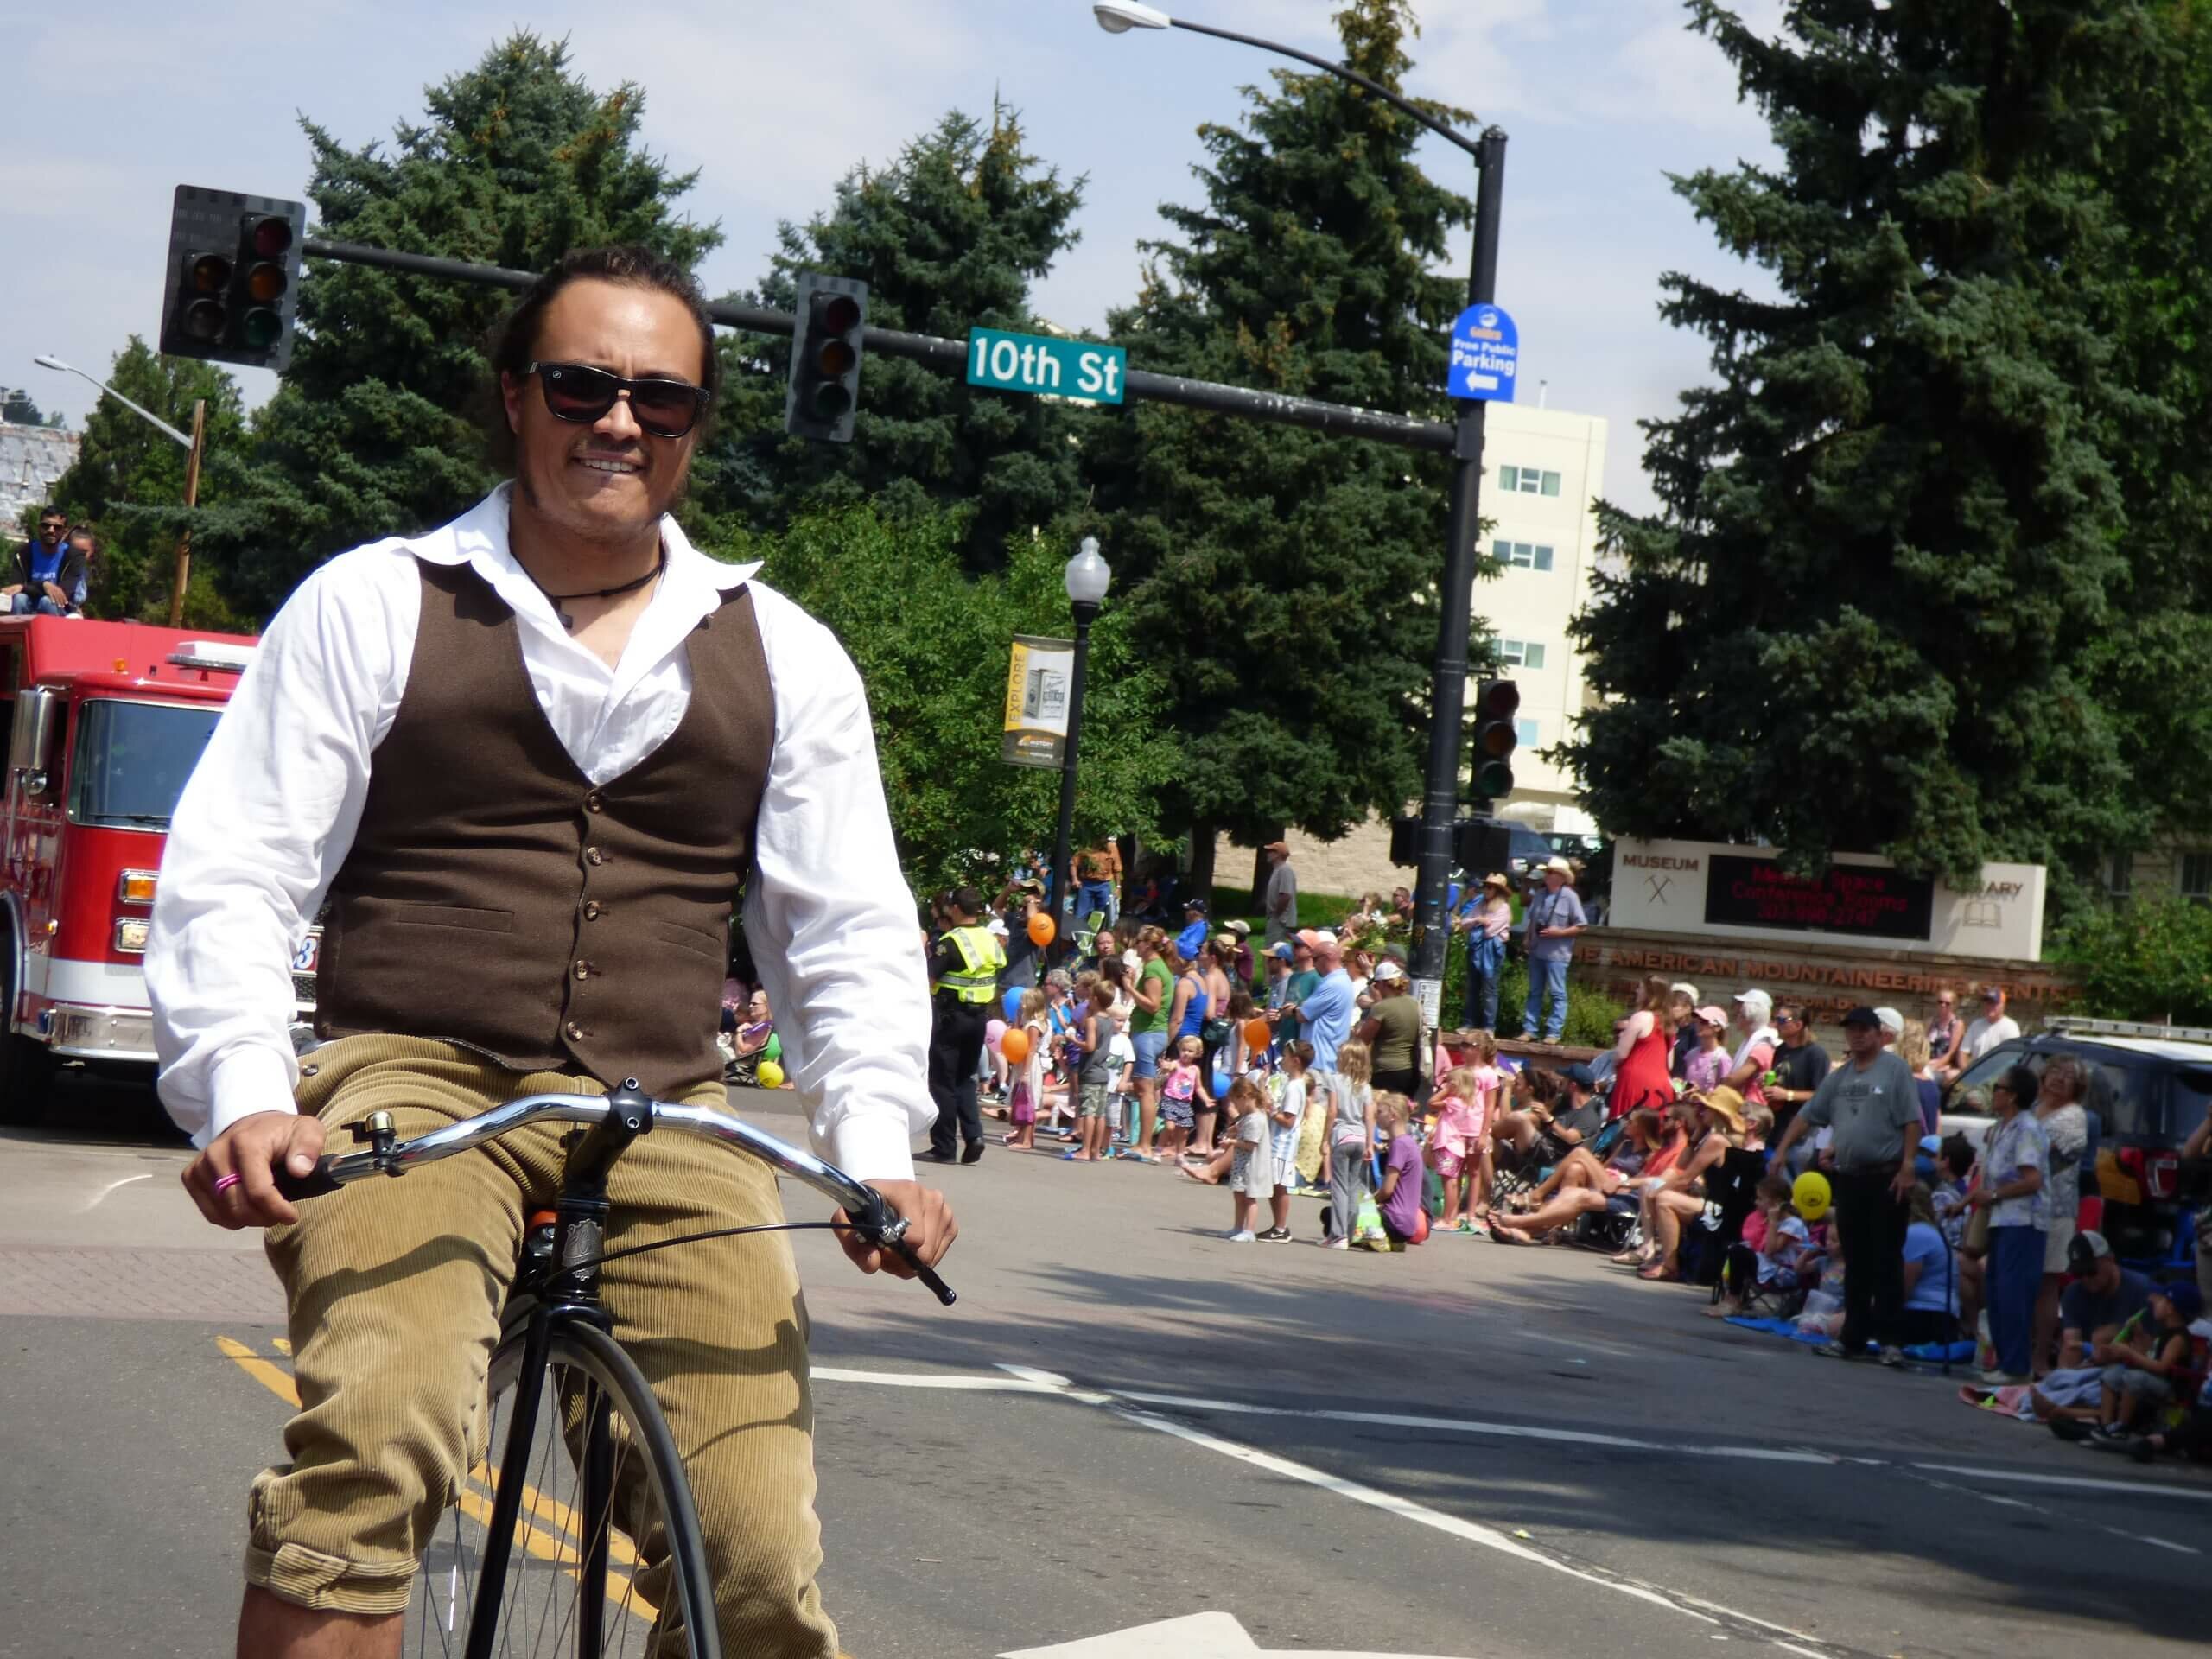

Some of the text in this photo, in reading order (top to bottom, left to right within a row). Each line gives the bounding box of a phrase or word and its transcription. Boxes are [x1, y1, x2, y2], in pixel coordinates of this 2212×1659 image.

[1452, 338, 1516, 356] Free Public
[976, 337, 1119, 396] 10th St
[1452, 349, 1515, 378] Parking
[1008, 652, 1025, 722] EXPLORE
[1623, 853, 1700, 872] MUSEUM
[1752, 865, 1823, 891] Meng
[1943, 877, 2024, 896] LARY
[1731, 880, 1836, 906] Conference
[1574, 947, 2082, 1002] HE AMERICAN MOUNTAINEERING CNTE
